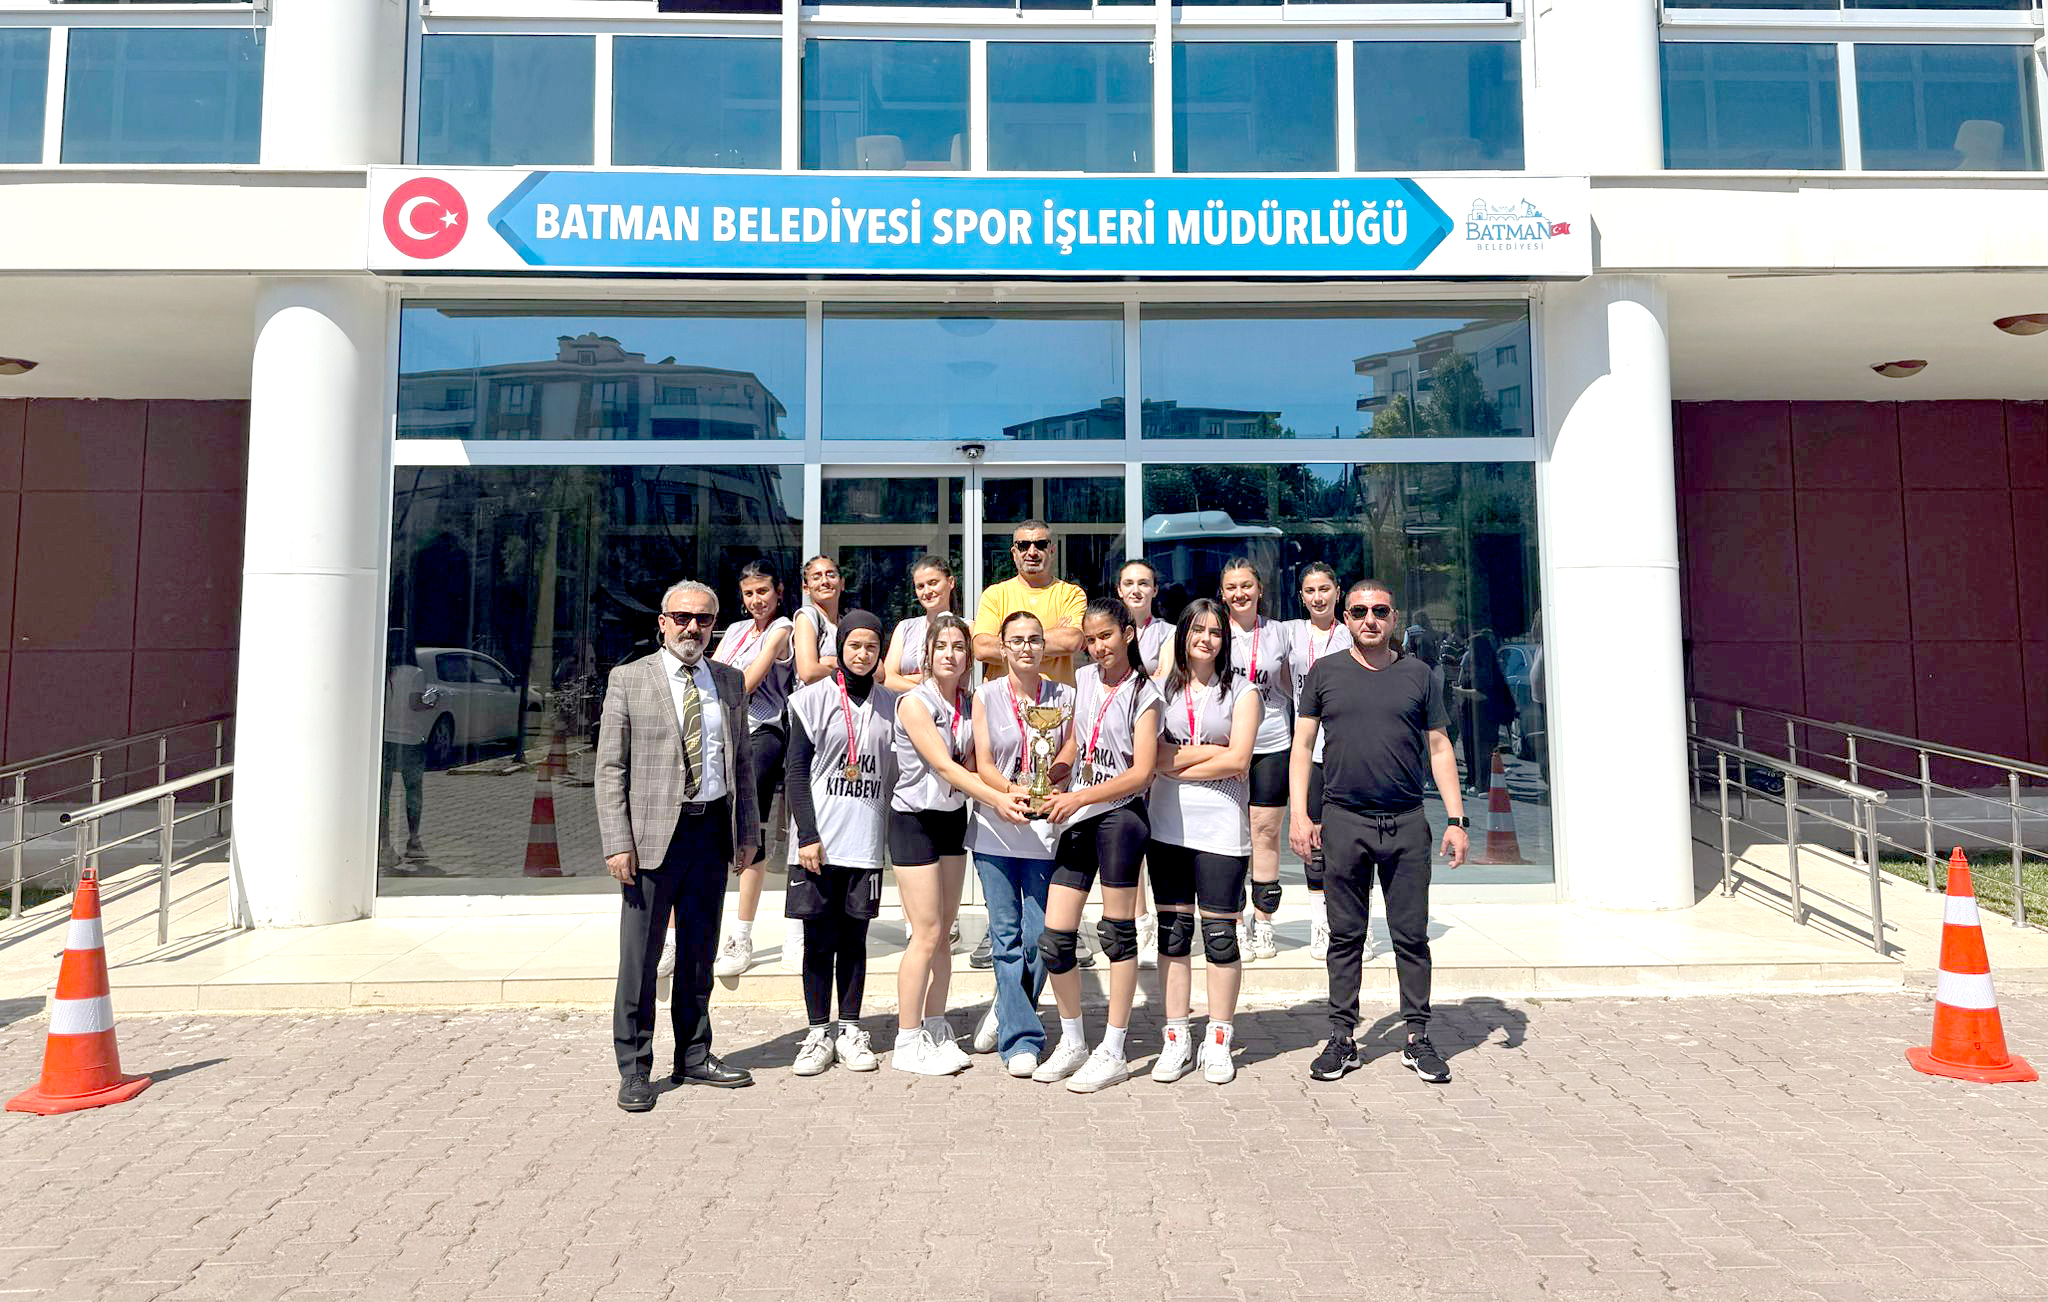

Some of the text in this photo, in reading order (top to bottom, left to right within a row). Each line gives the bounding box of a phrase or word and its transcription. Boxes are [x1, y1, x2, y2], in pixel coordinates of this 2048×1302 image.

[535, 197, 1408, 255] BATMAN BELEDİYESİ SPOR İŞLERİ MÜDÜRLÜĞÜ
[1466, 222, 1551, 240] BATMAN
[1477, 242, 1544, 251] BELEDİYESİ
[1231, 667, 1268, 685] BEKA
[839, 753, 876, 774] BKA
[1080, 742, 1117, 769] RKA
[869, 873, 880, 900] 11
